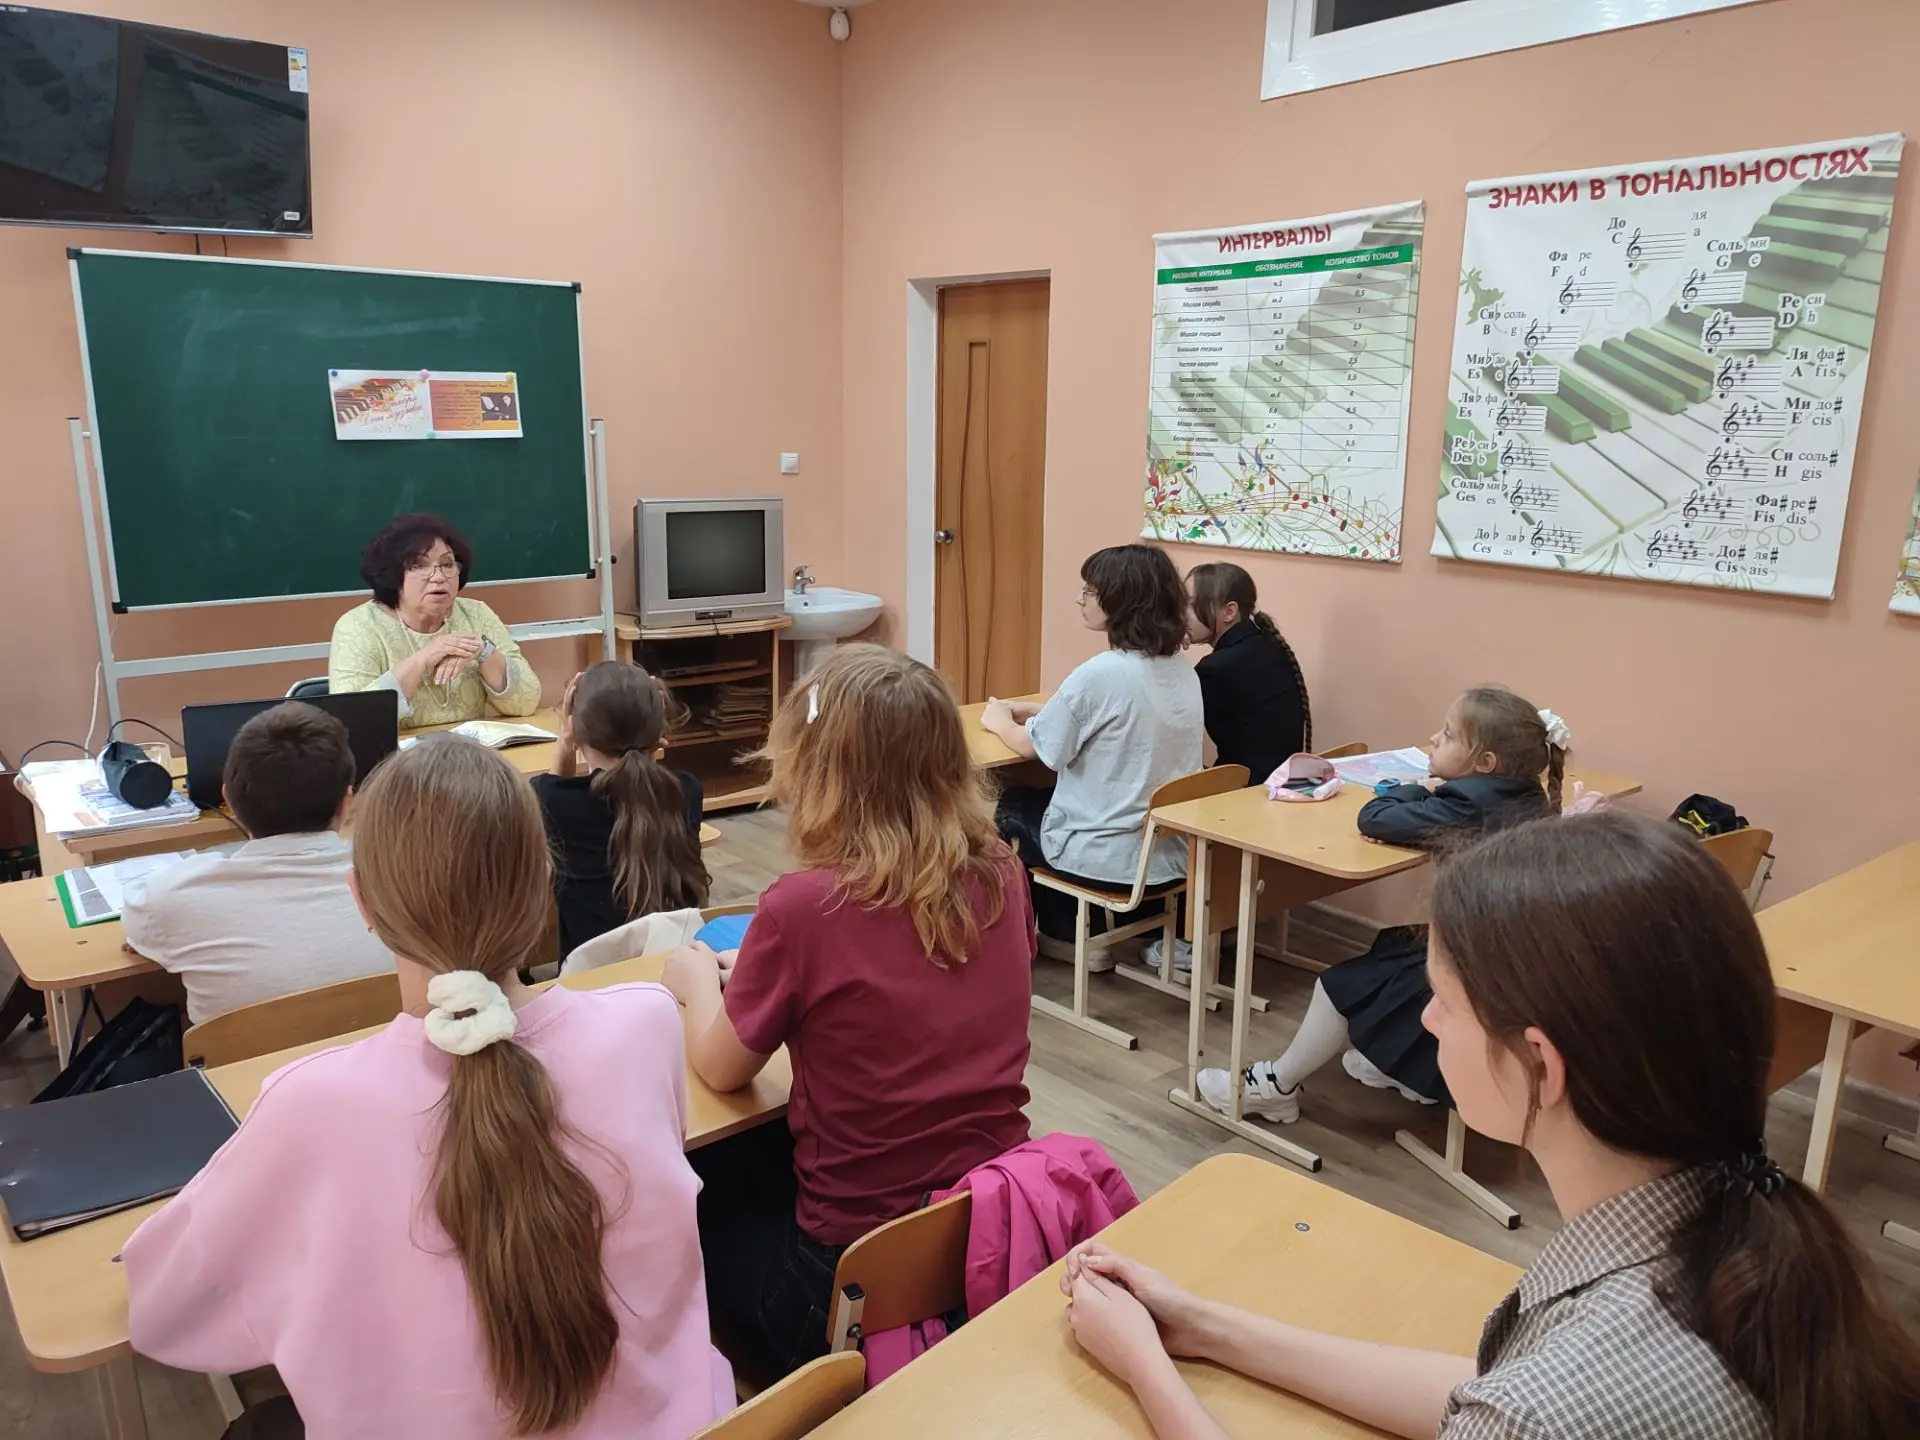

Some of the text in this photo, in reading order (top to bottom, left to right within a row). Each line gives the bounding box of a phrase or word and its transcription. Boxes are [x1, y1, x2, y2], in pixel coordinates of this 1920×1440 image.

[1488, 146, 1870, 208] ЗНАКИ В ТОНАЛЬНОСТЯХ
[1690, 211, 1708, 221] ля
[1607, 217, 1627, 231] До
[1693, 227, 1701, 236] a
[1217, 224, 1332, 254] ИНТЕРВАЛЫ
[1611, 232, 1624, 244] C
[1749, 239, 1767, 249] ми
[1707, 239, 1744, 252] Соль
[1324, 250, 1399, 266] КОЛИЧЕСТВО ТОНОВ
[1548, 250, 1568, 262] Фа
[1716, 254, 1729, 267] G
[1751, 256, 1759, 265] e
[1254, 260, 1304, 272] ОБОЗНАЧЕНИЕ
[1551, 266, 1561, 277] F
[1579, 265, 1588, 277] d
[1781, 295, 1800, 308] Ре
[1806, 295, 1822, 305] си
[1504, 311, 1527, 319] соль
[1782, 312, 1795, 325] D
[1808, 311, 1816, 322] h
[1483, 324, 1491, 335] B
[1511, 326, 1518, 336] g
[1786, 348, 1808, 360] Ля
[1468, 368, 1481, 379] Es
[1791, 365, 1803, 377] A
[1815, 363, 1837, 377] fis
[1485, 392, 1498, 405] фа
[1784, 397, 1811, 410] Ми
[1791, 412, 1802, 424] E
[1812, 413, 1832, 426] cis
[1453, 451, 1473, 463] Des
[1771, 448, 1793, 461] Си
[1774, 465, 1788, 477] H
[1800, 466, 1823, 481] gis
[1456, 491, 1476, 502] Ges
[1486, 497, 1496, 505] es
[1753, 510, 1775, 523] Fis
[1786, 512, 1808, 525] dis
[1472, 542, 1492, 554] Ces
[1503, 548, 1513, 556] as
[1715, 560, 1738, 573] Cis
[1749, 564, 1769, 576] ais
